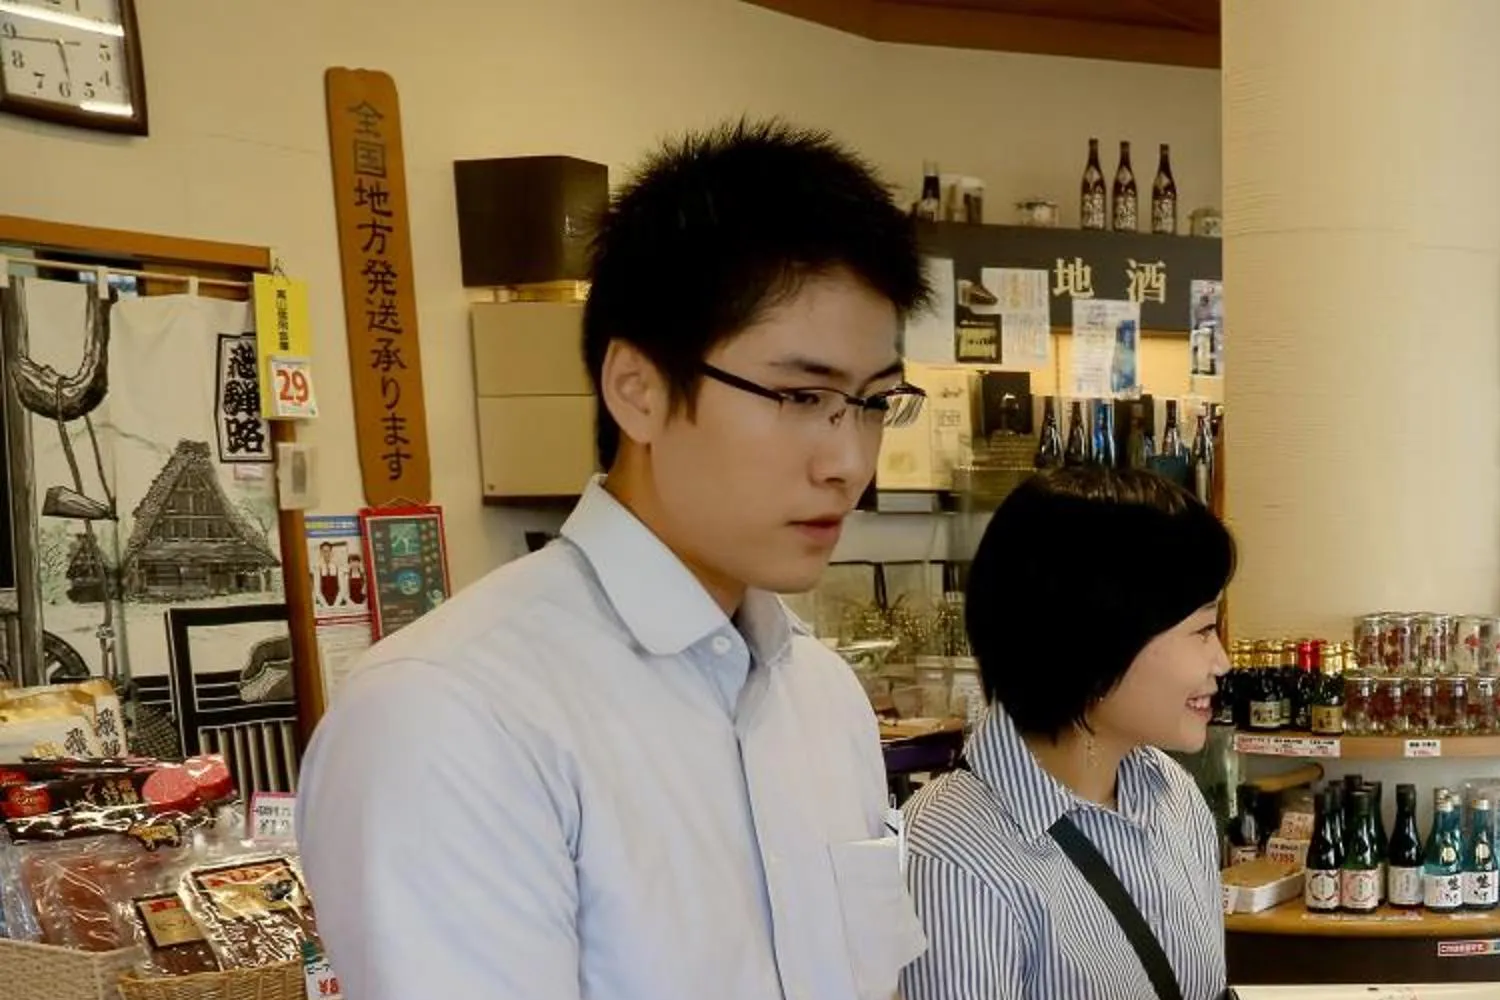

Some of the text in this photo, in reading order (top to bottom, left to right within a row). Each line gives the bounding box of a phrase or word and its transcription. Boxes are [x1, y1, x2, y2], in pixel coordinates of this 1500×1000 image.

[33, 71, 45, 89] 7
[59, 81, 71, 98] 6
[84, 82, 95, 98] 5
[347, 101, 414, 481] 全国地方発送承ります
[1053, 257, 1167, 303] 地酒
[276, 369, 309, 403] 29
